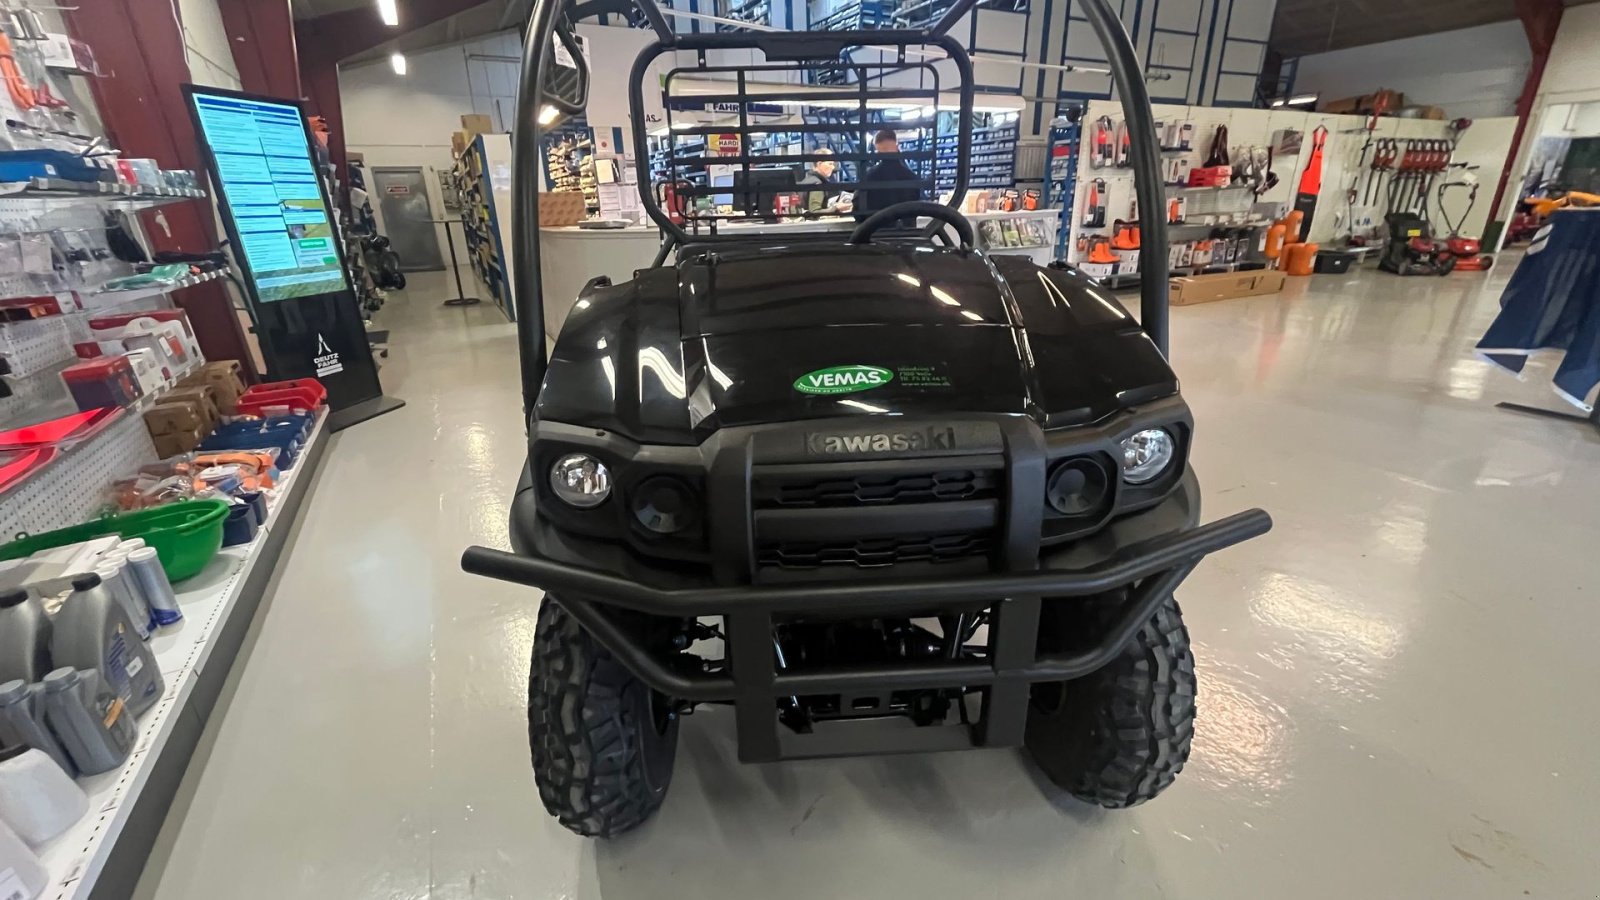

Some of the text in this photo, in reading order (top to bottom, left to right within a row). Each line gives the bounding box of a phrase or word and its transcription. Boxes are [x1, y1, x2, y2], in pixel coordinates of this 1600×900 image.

[713, 103, 739, 112] FAHR
[313, 352, 339, 364] DEUTZ
[317, 358, 339, 369] FAHR
[808, 371, 882, 387] VEMAS
[804, 426, 956, 454] Kawasaki
